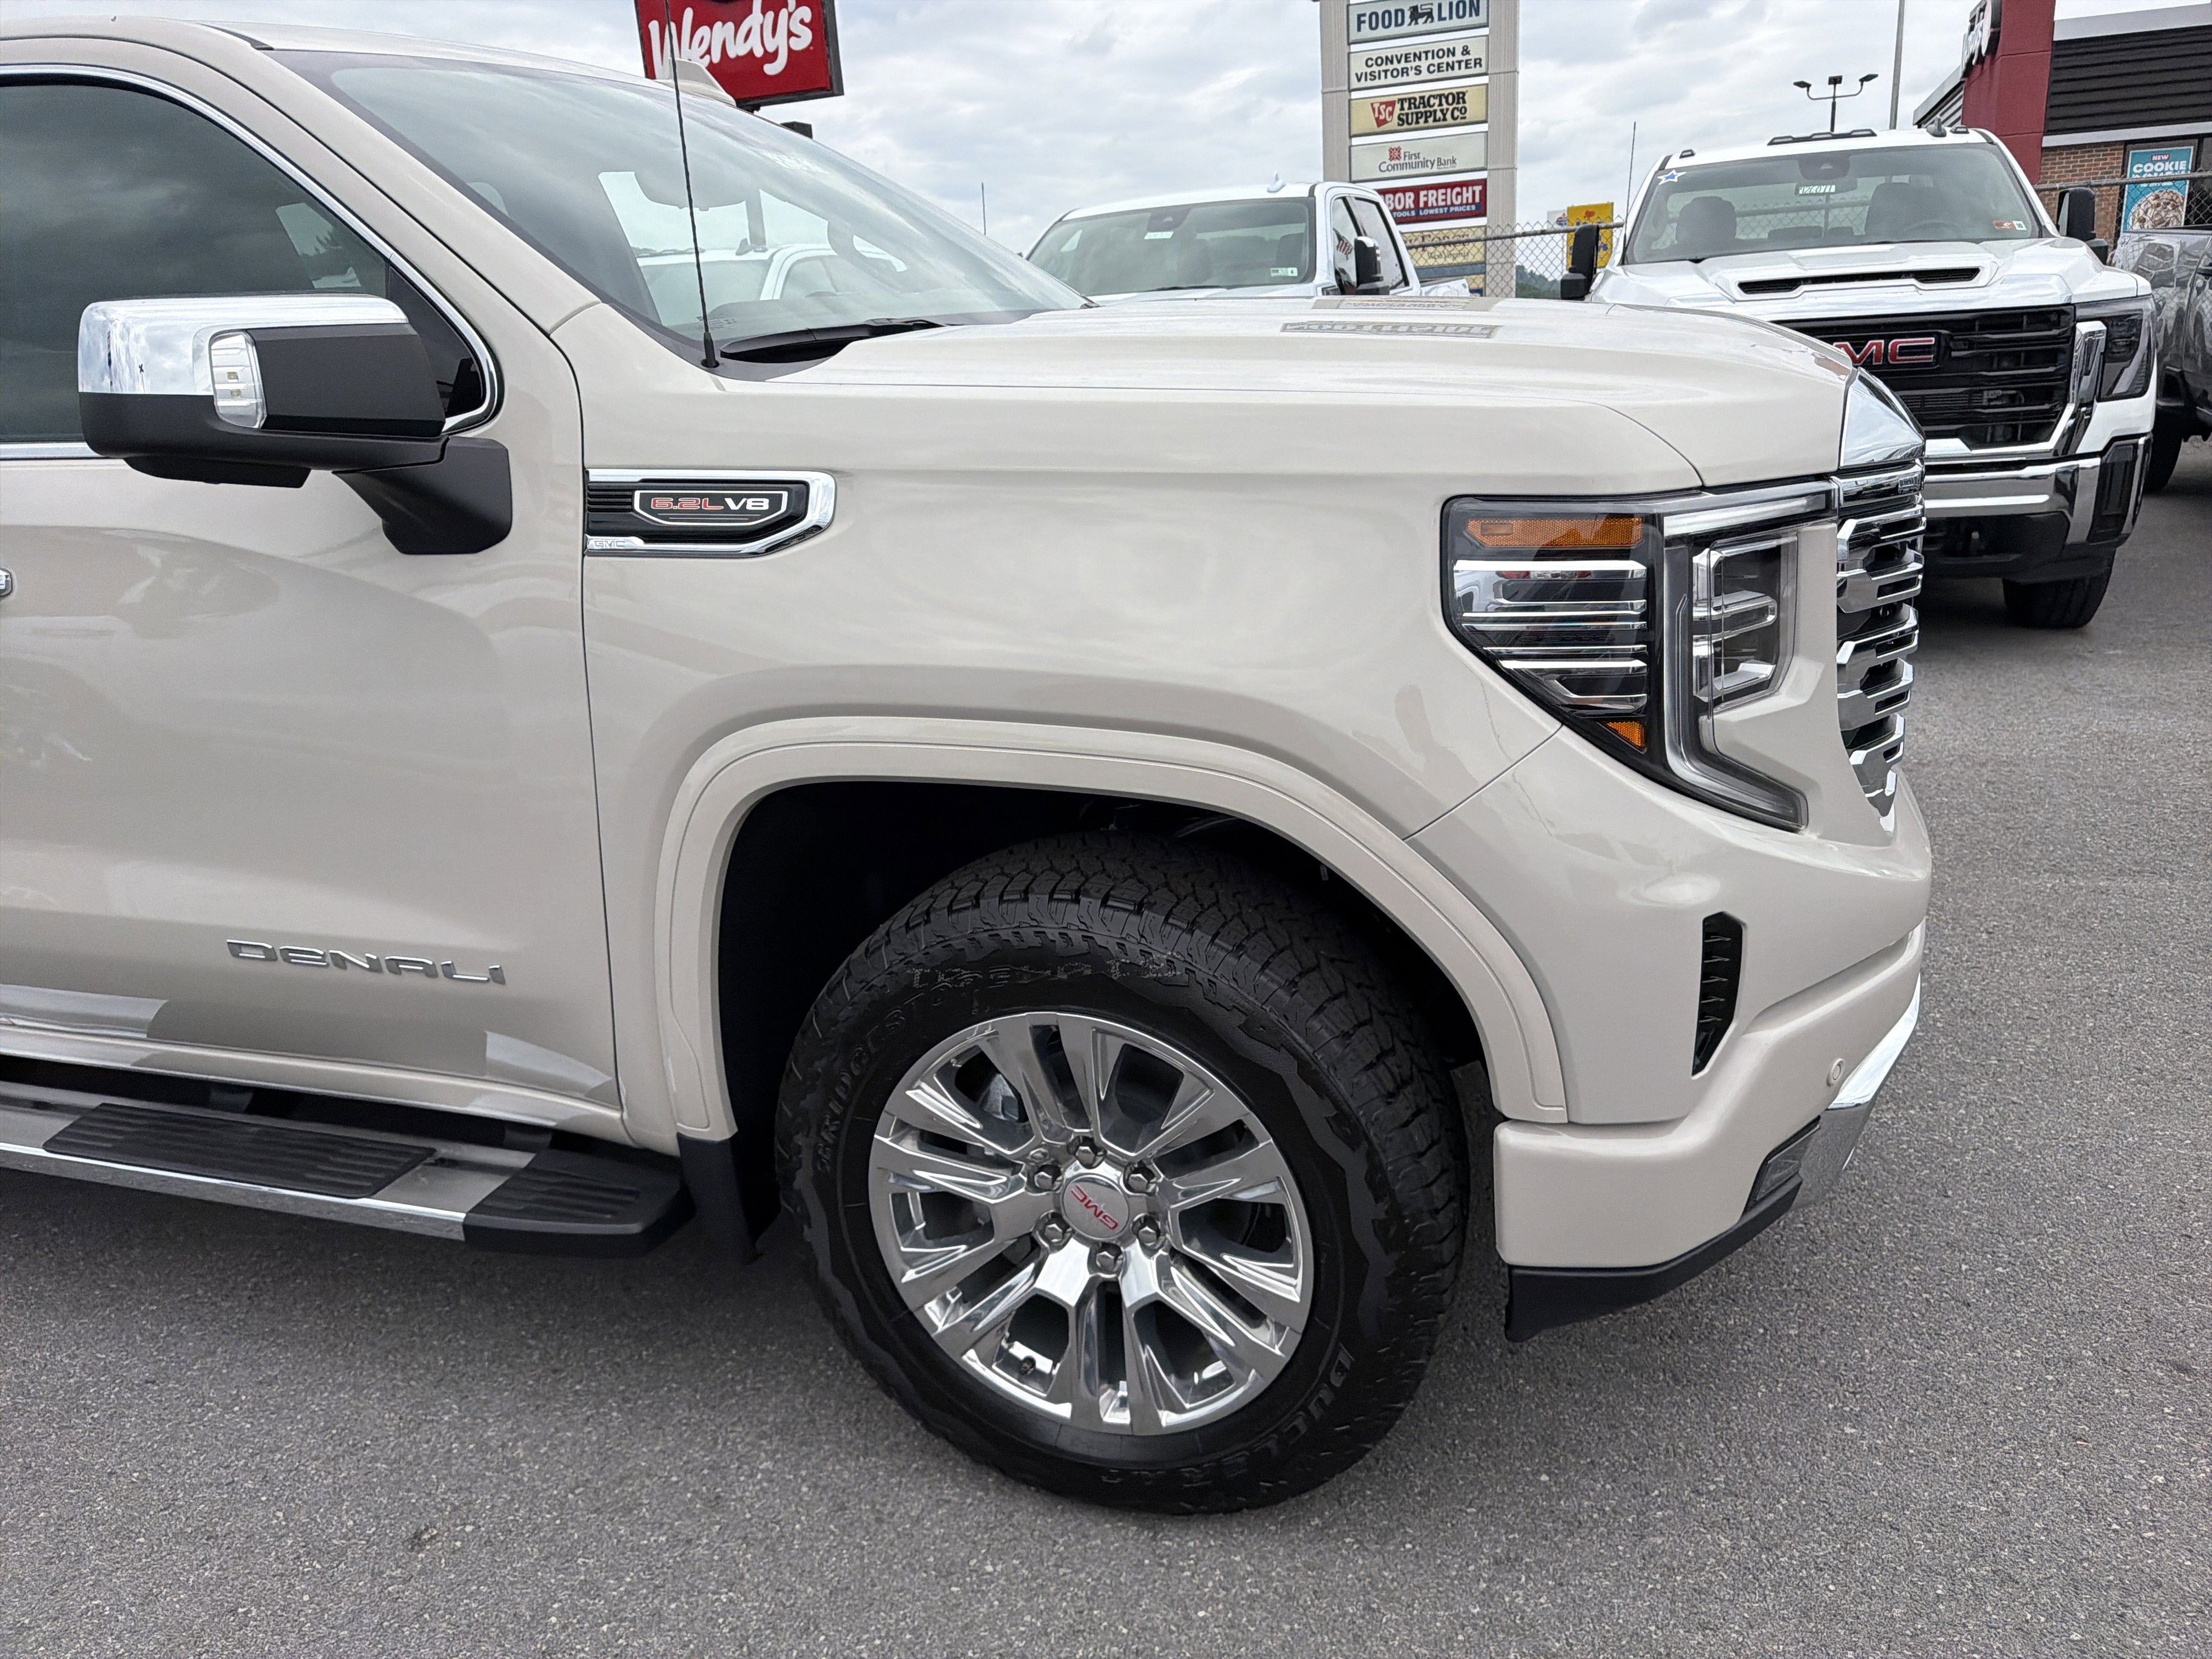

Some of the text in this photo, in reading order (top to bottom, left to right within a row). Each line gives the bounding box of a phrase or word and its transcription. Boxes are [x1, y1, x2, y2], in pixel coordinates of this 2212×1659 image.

[1356, 0, 1481, 32] FOOD LION
[648, 0, 812, 80] Wendy's
[1365, 44, 1471, 68] CONVENTION &
[1355, 57, 1483, 83] VISITOR'S CENTER
[1372, 102, 1393, 122] TSC
[1397, 91, 1467, 111] TRACTOR
[1397, 108, 1451, 127] SUPPLY
[1378, 156, 1436, 173] Community
[1436, 156, 1457, 167] Bank
[1403, 151, 1421, 161] First
[2132, 160, 2187, 173] COOKIE
[1381, 185, 1482, 211] BOR FREIGHT
[1392, 204, 1476, 218] TOOLS LOWEST PRICES
[1833, 337, 1936, 365] MC
[651, 497, 770, 510] 6.2L V8
[226, 939, 506, 986] DENALI
[1070, 1184, 1119, 1230] GMC
